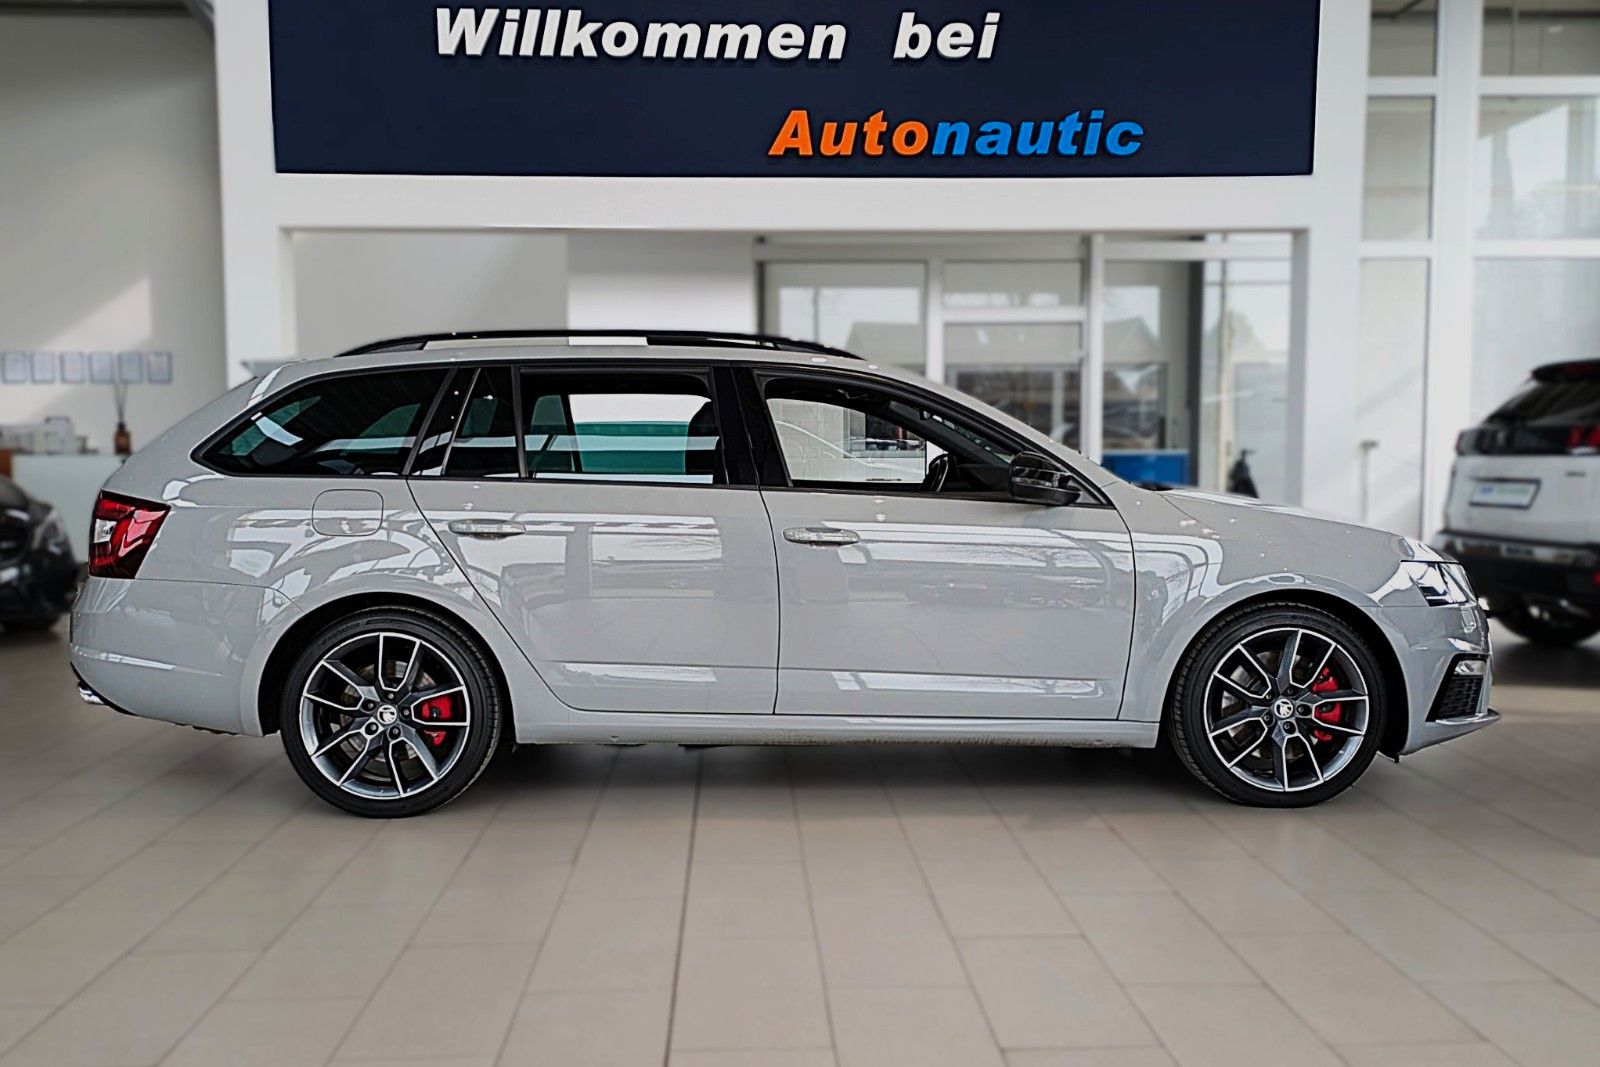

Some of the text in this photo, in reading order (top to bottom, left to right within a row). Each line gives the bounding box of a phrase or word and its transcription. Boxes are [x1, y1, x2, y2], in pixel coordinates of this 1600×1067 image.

[436, 7, 1001, 60] Willkommen bei
[768, 109, 1144, 156] Autonautic
